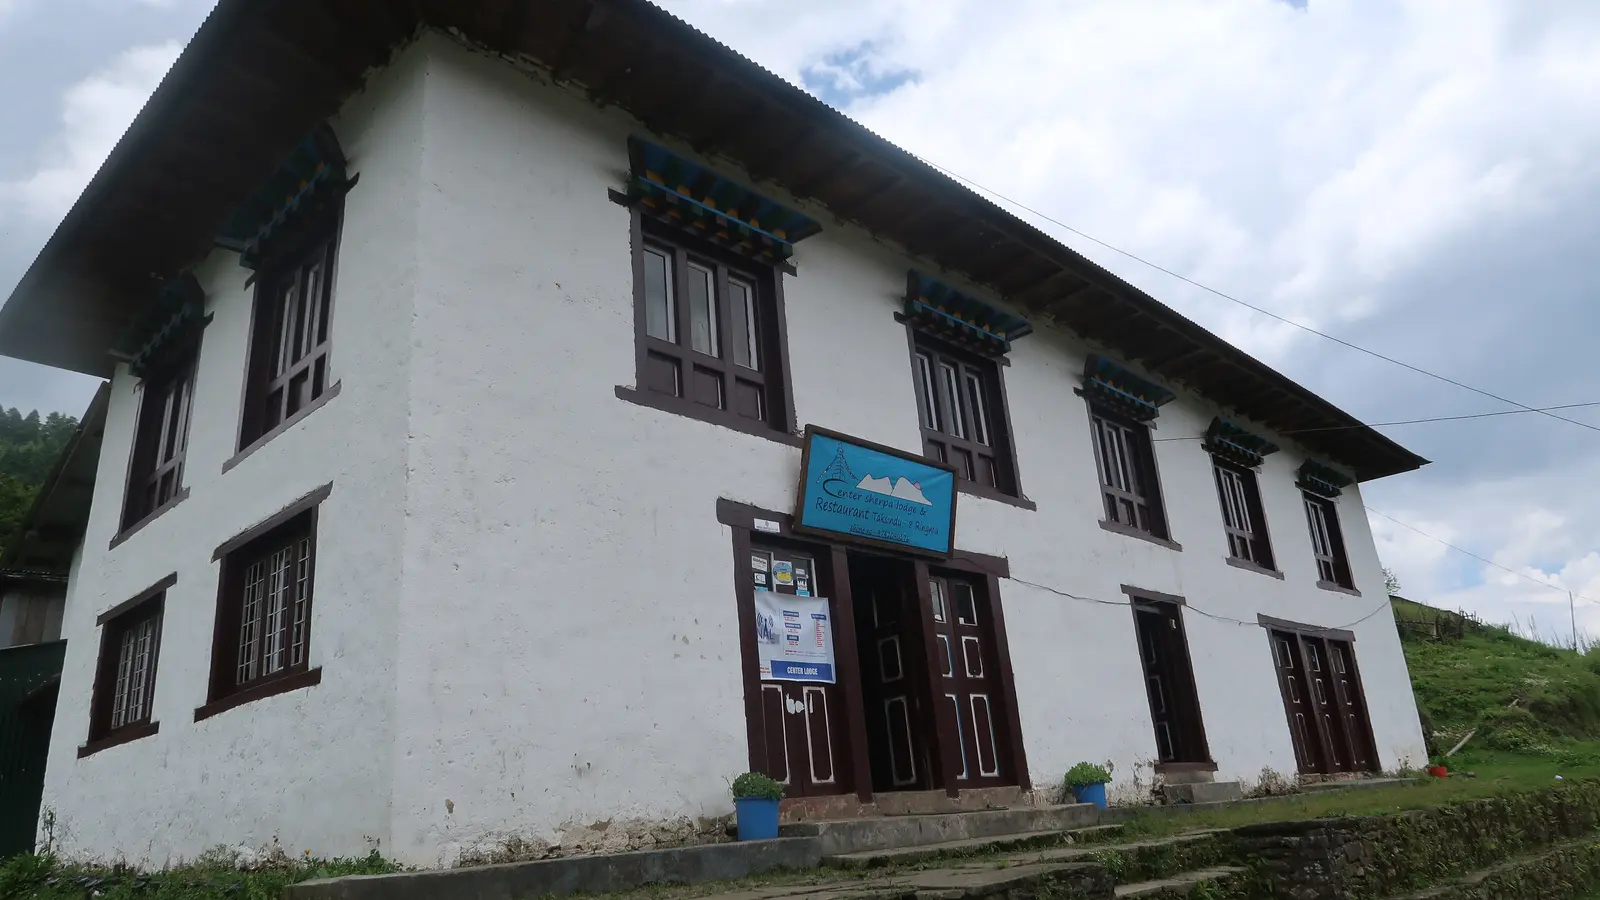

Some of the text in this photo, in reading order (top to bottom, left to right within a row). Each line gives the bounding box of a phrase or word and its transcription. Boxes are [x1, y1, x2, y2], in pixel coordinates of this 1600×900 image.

[815, 496, 870, 521] Restaurant
[823, 478, 862, 500] Center
[919, 508, 926, 516] &
